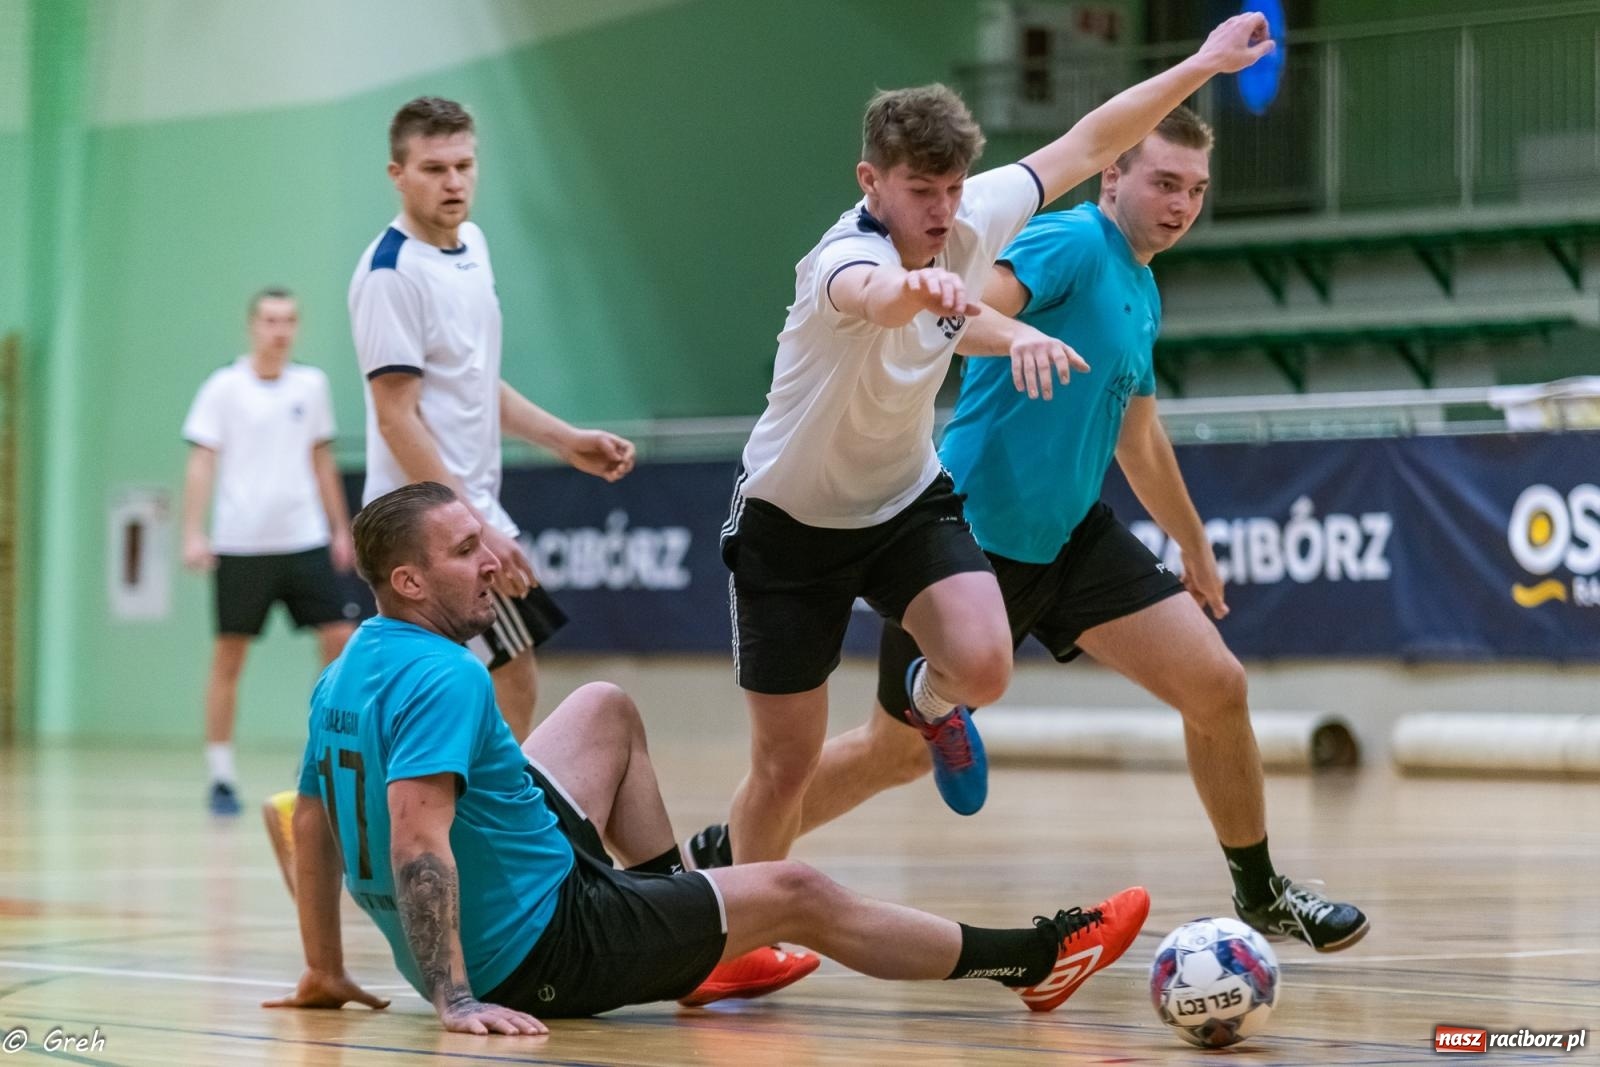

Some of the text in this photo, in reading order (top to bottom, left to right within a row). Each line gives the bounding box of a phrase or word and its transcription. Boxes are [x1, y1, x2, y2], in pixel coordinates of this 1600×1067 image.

[525, 509, 692, 590] CIBÓRZ
[316, 745, 374, 880] 17
[1176, 987, 1243, 1016] SELECT
